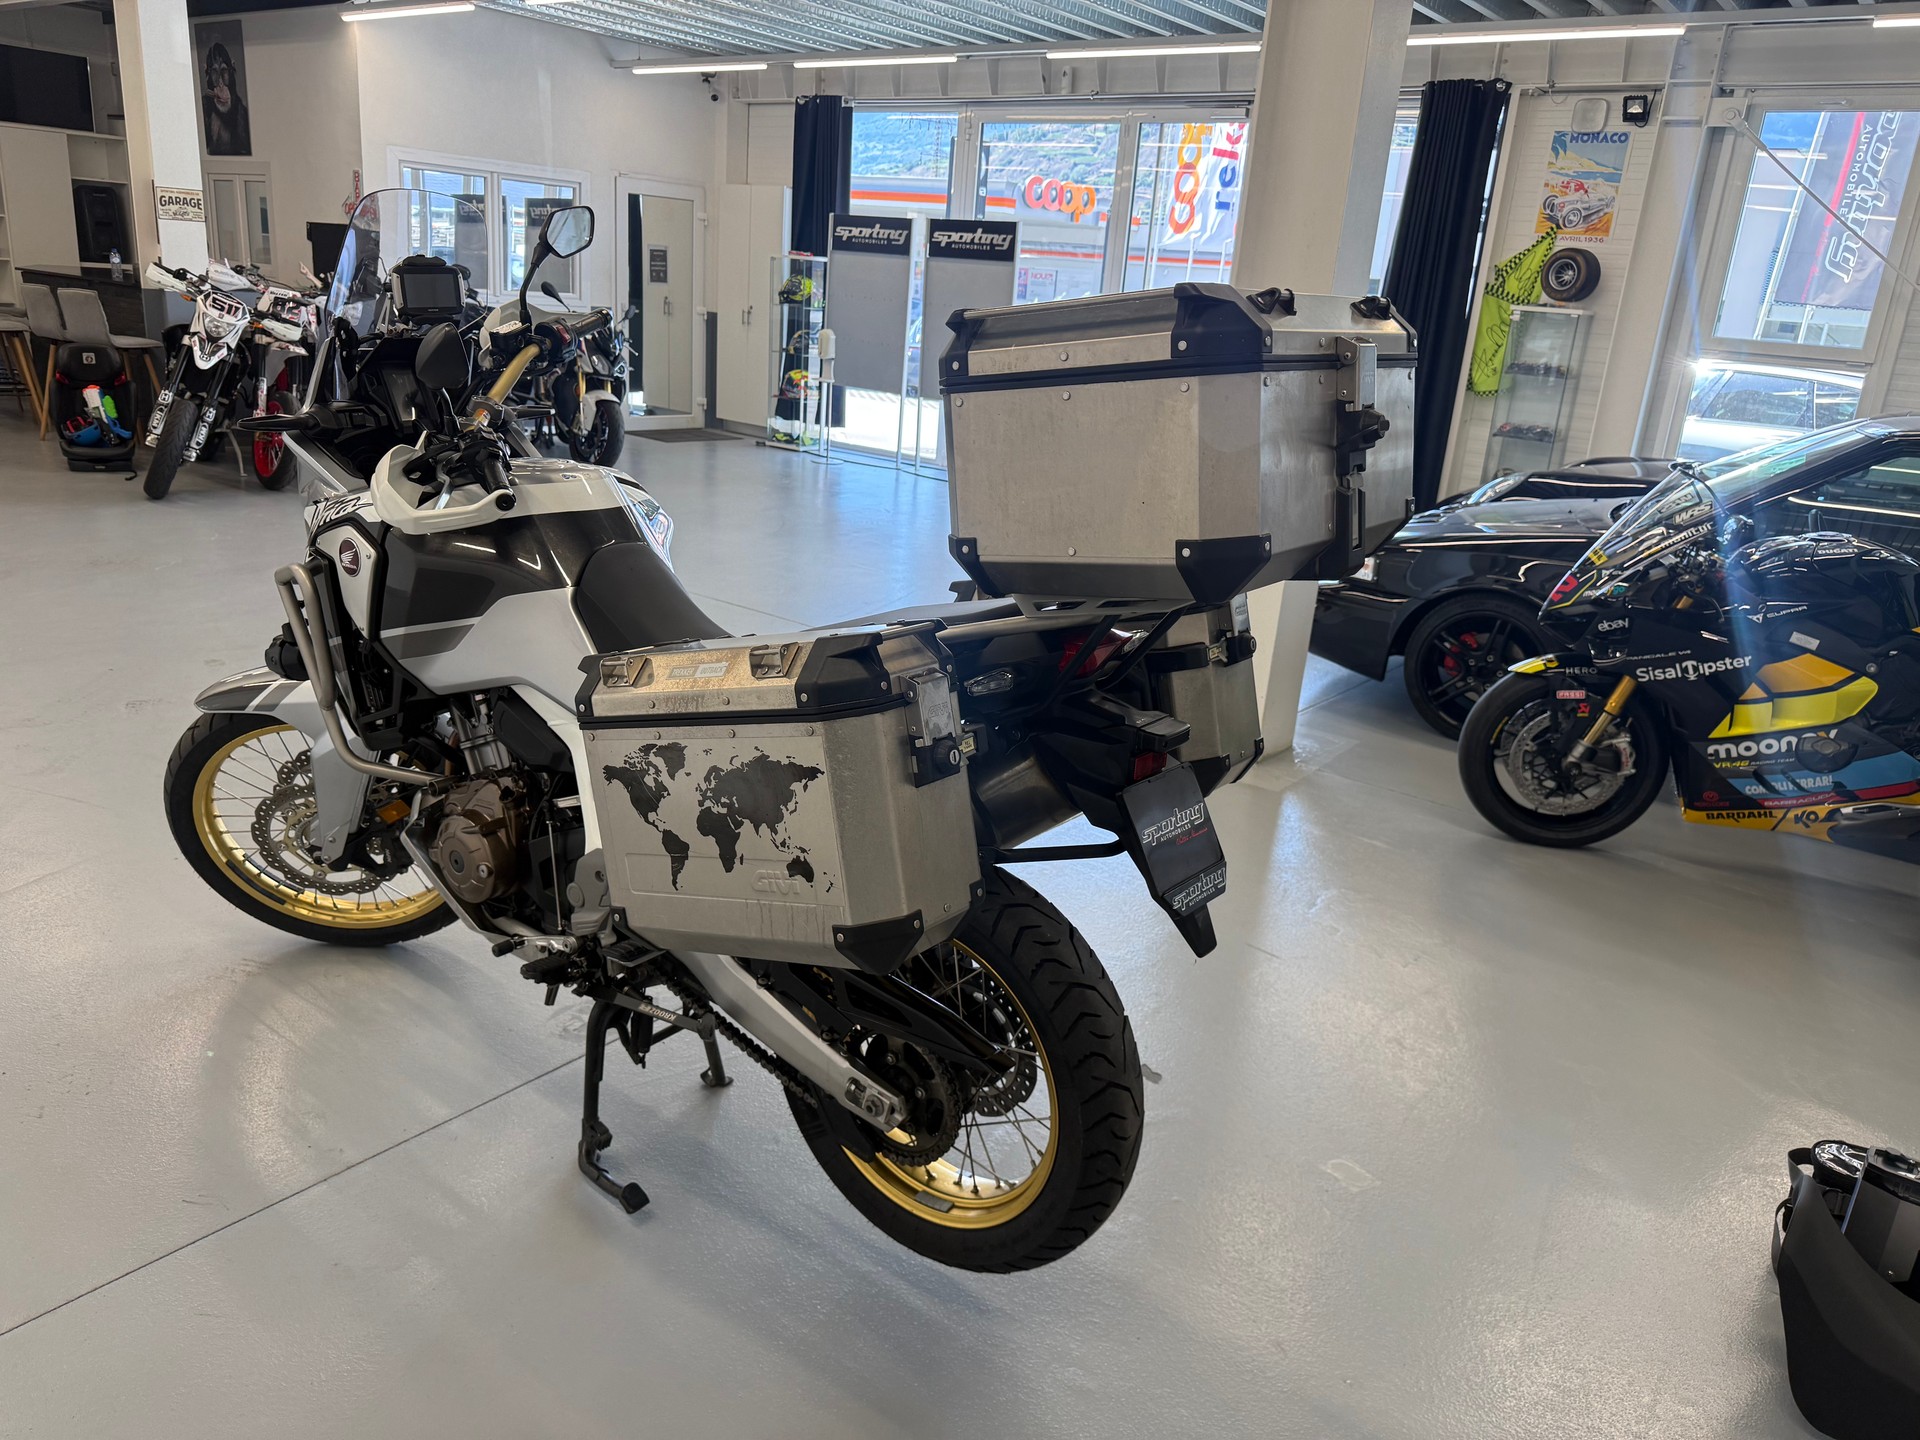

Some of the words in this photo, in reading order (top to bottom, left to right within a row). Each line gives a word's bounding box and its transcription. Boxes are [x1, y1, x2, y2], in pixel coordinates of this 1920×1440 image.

[1569, 131, 1629, 144] MONACO
[159, 194, 203, 211] GARAGE
[1025, 175, 1097, 223] coop
[834, 223, 909, 245] sporting
[852, 237, 888, 245] AUTOMOBILES
[931, 227, 1013, 250] sporting
[1559, 235, 1583, 243] AVRIL
[1584, 236, 1604, 244] 1936
[951, 243, 990, 251] AUTOMOBILES
[1675, 502, 1713, 524] WRS
[1766, 605, 1808, 619] CUPRA
[1597, 618, 1629, 632] ebay
[1565, 666, 1598, 675] HERO
[1707, 729, 1838, 759] moon
[1141, 802, 1205, 846] sporting
[1706, 810, 1777, 823] BARDAHL
[1160, 823, 1191, 842] AUTOMOBILES
[751, 869, 800, 896] GIVI
[1172, 867, 1226, 911] sporting
[1189, 887, 1215, 907] AUTOMOBILES
